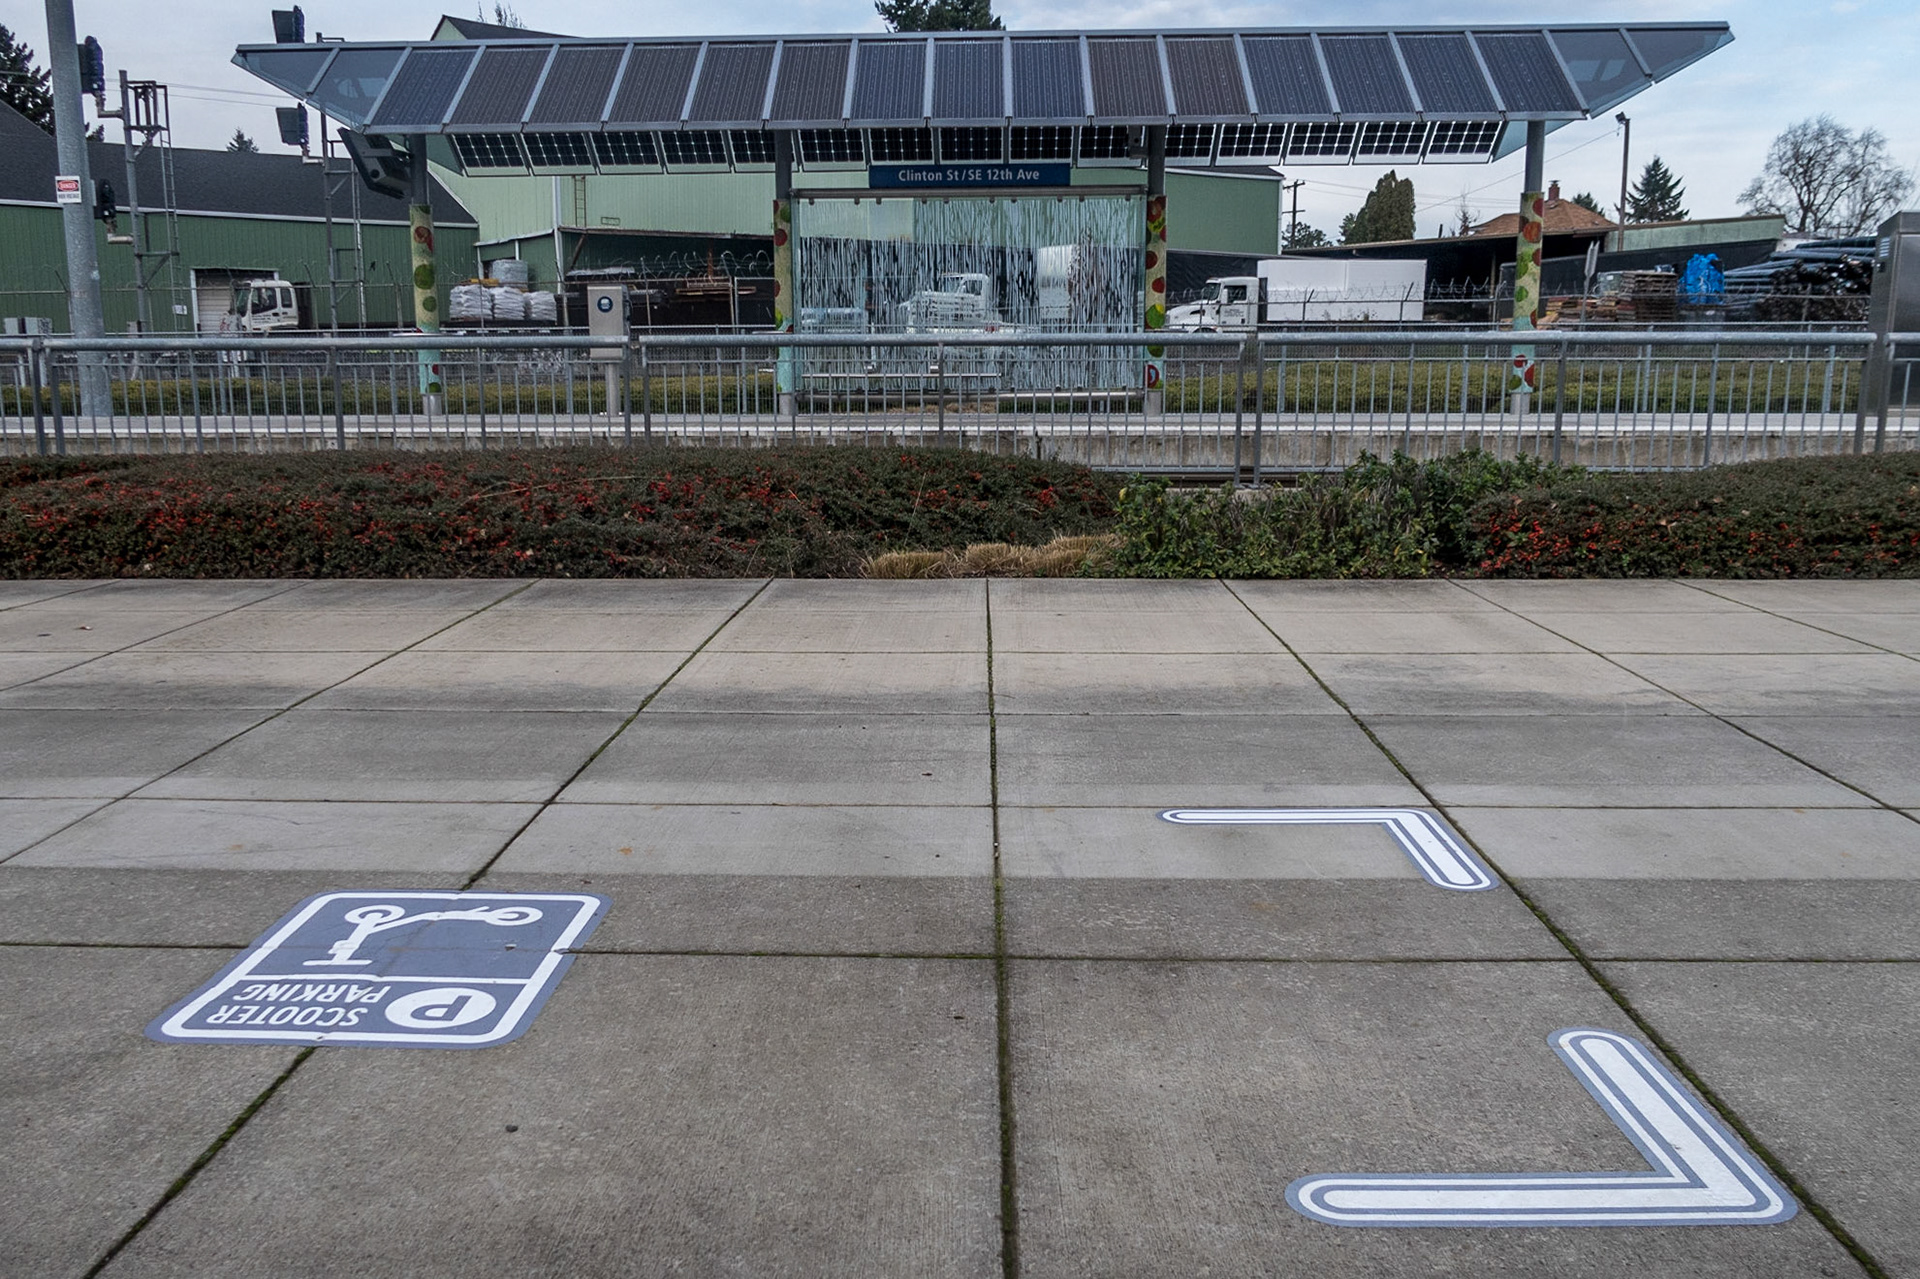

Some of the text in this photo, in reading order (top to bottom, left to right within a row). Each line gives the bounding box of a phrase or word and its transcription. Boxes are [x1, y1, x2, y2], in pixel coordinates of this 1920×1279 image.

[898, 169, 943, 182] Clinton
[987, 168, 1013, 181] 12th
[1016, 168, 1040, 181] Ave
[233, 983, 391, 1003] PARKING
[206, 1005, 368, 1027] SCOOTER
[410, 995, 474, 1021] P
